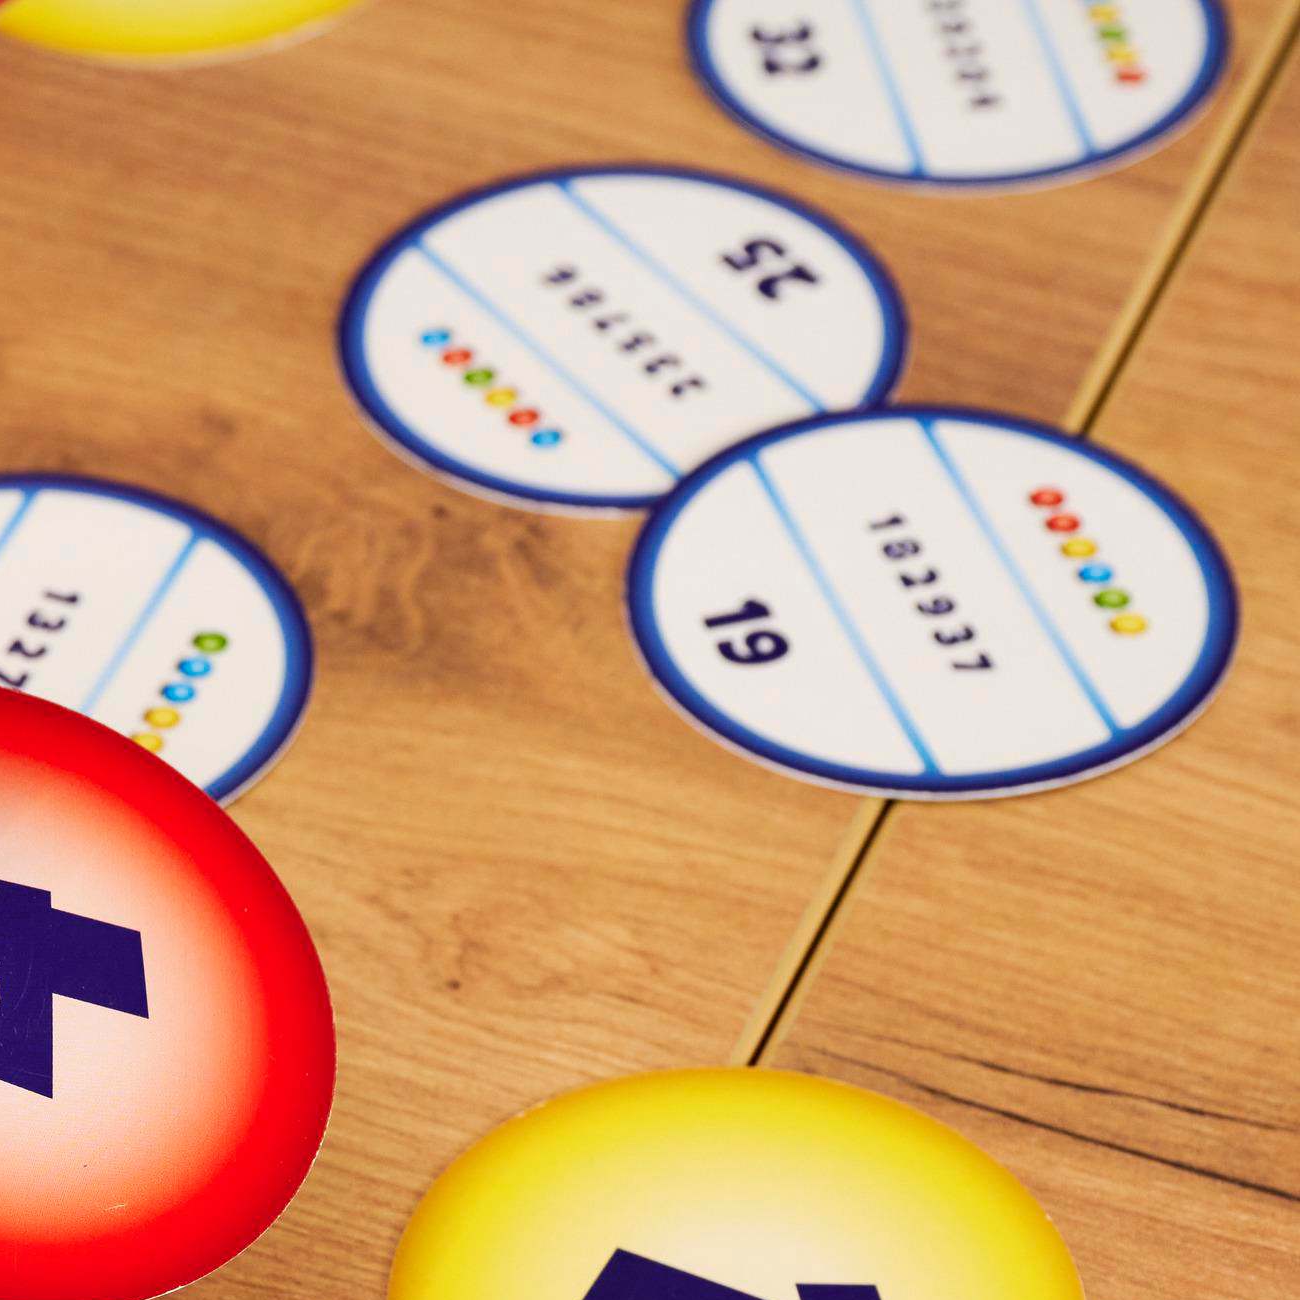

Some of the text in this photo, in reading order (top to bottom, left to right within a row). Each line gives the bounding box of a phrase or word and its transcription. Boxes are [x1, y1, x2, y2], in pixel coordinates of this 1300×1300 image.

[720, 236, 820, 300] 25
[868, 513, 994, 671] 182937
[701, 597, 791, 667] 19
